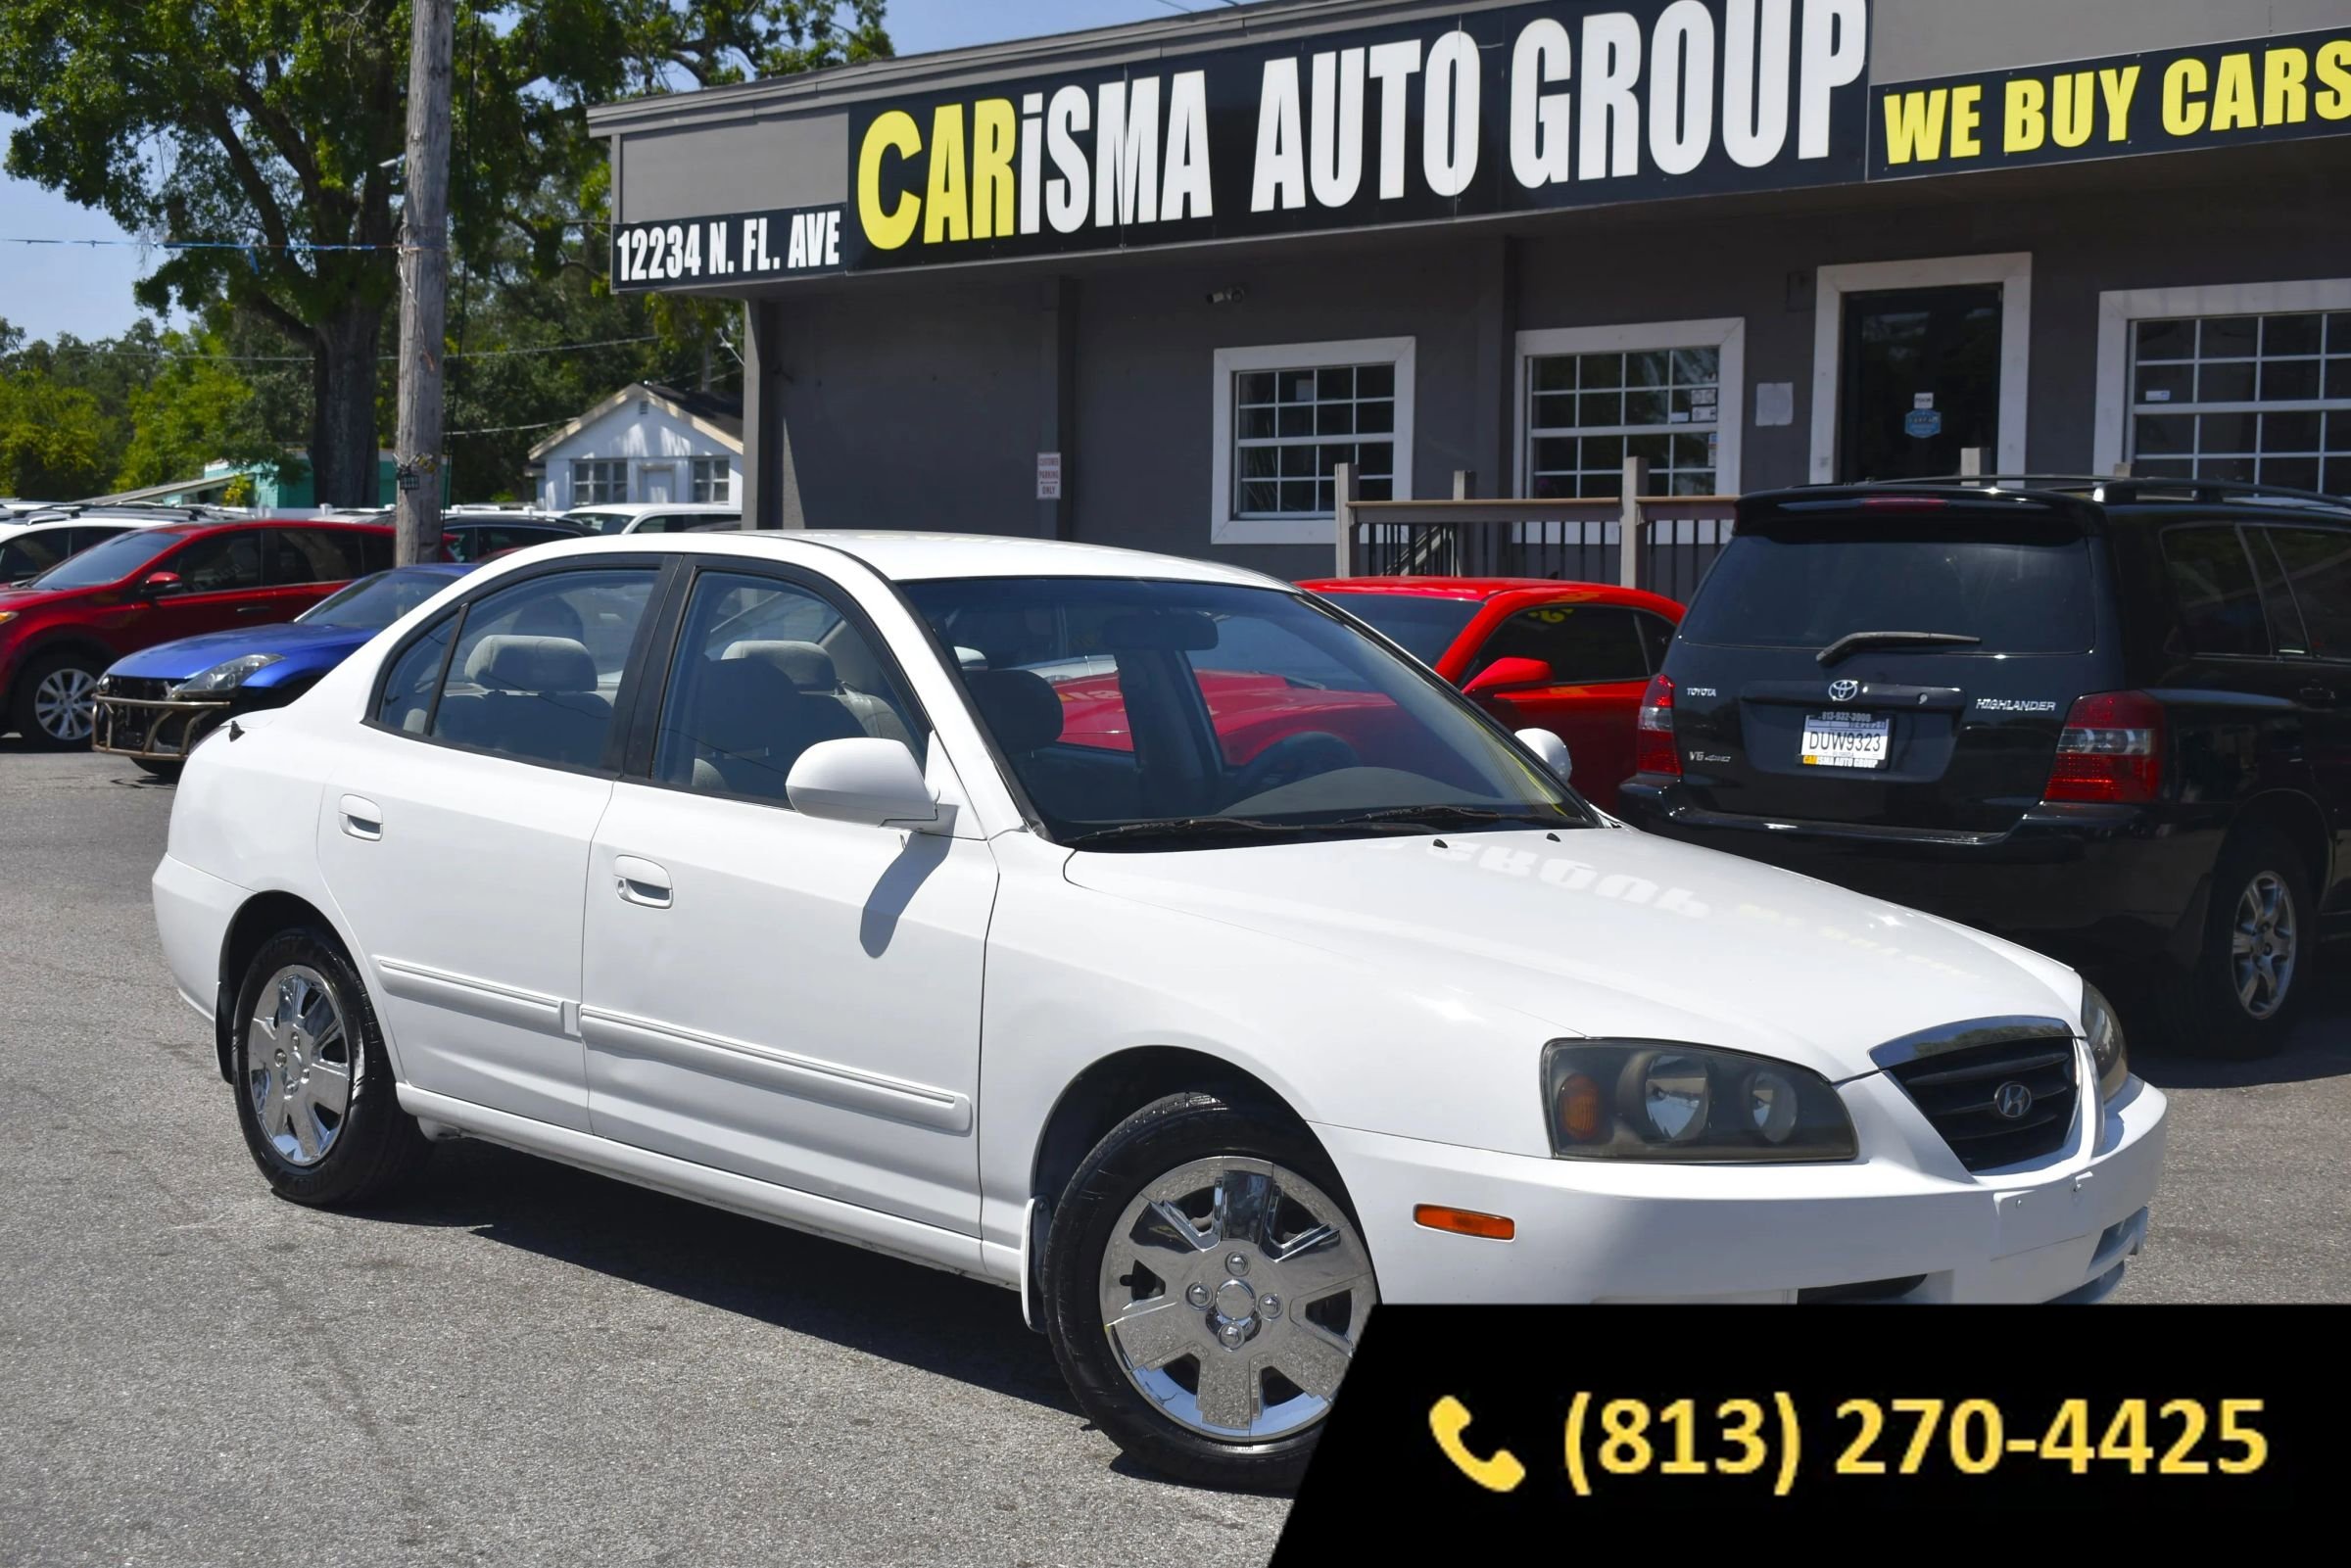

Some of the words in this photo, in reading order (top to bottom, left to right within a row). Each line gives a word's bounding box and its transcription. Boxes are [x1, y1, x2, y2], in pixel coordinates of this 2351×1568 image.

[1250, 30, 1481, 213] AUTO
[1510, 0, 1866, 189] GROUP
[1884, 84, 1982, 165] WE
[2003, 66, 2141, 154] BUY
[2161, 40, 2351, 136] CARS
[617, 224, 701, 281] 12234
[708, 221, 735, 275] N.
[743, 217, 781, 272] FL.
[788, 211, 840, 268] AVE
[1687, 688, 1716, 697] TOYOTA
[1975, 698, 2056, 712] HIGHLANDER
[1808, 731, 1881, 752] DUW9323
